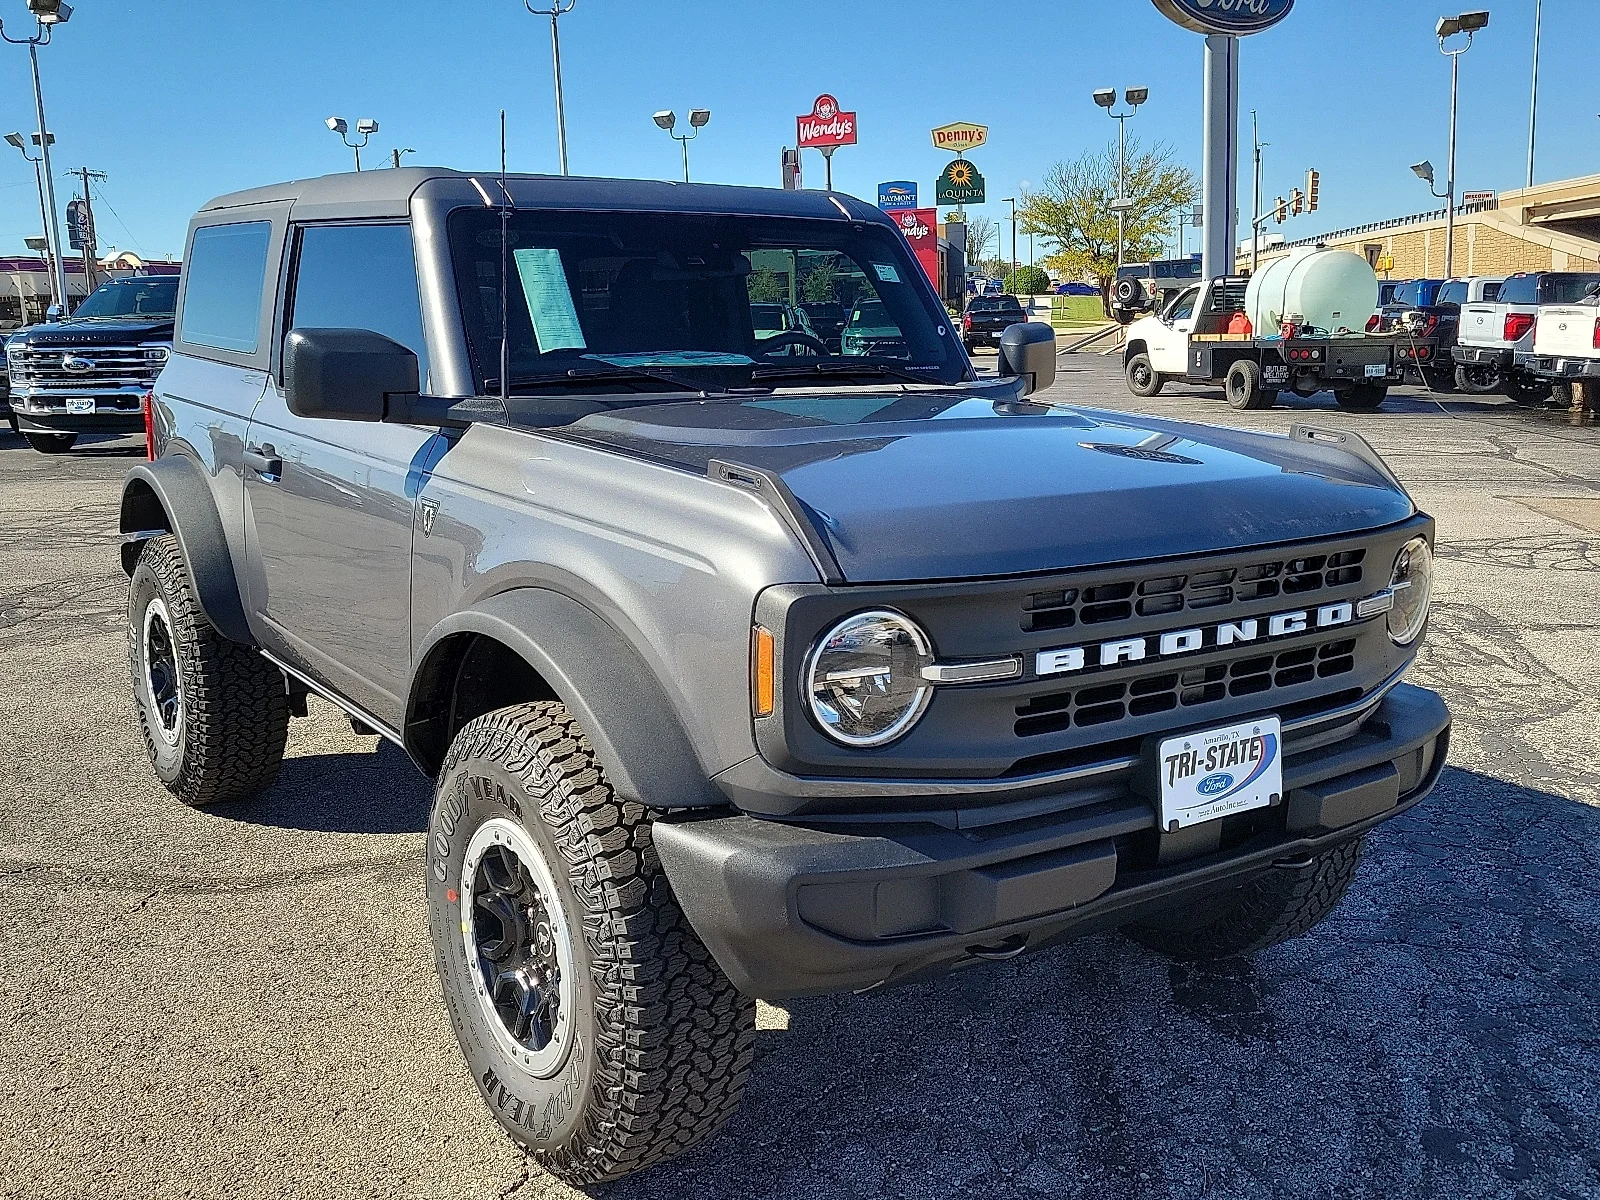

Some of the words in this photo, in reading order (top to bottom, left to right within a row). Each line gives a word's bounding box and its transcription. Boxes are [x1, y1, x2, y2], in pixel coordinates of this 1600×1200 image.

[800, 116, 852, 142] Wendy's
[937, 128, 983, 143] Denny's
[880, 194, 916, 202] BAYMONT
[945, 189, 984, 199] QUINTA
[1263, 371, 1289, 379] WELDING
[1265, 365, 1288, 373] BUTLER
[1036, 603, 1352, 675] BRONCO
[1203, 733, 1231, 745] Amarillo,
[1231, 731, 1240, 739] TX
[1165, 736, 1260, 788] TRI-STATE
[1203, 775, 1227, 793] Ford
